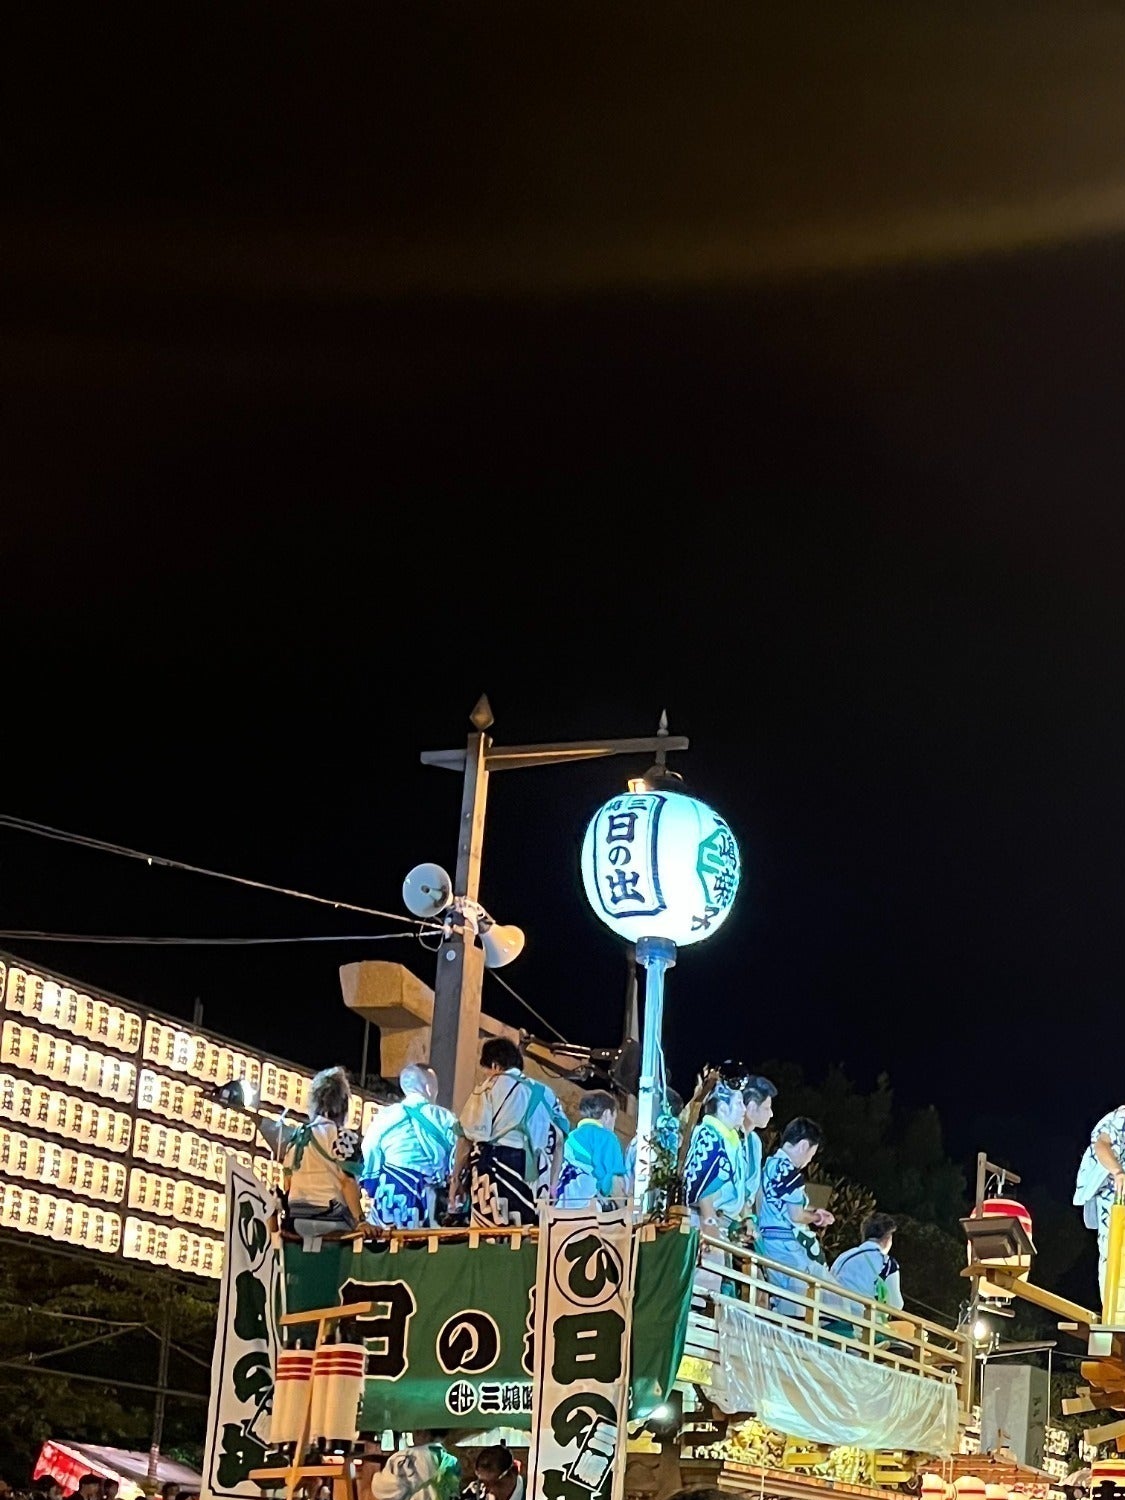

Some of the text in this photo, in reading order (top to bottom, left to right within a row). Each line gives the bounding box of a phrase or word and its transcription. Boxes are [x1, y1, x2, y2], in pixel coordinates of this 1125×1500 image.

[605, 812, 646, 904] 日の出
[340, 1279, 535, 1381] 日の
